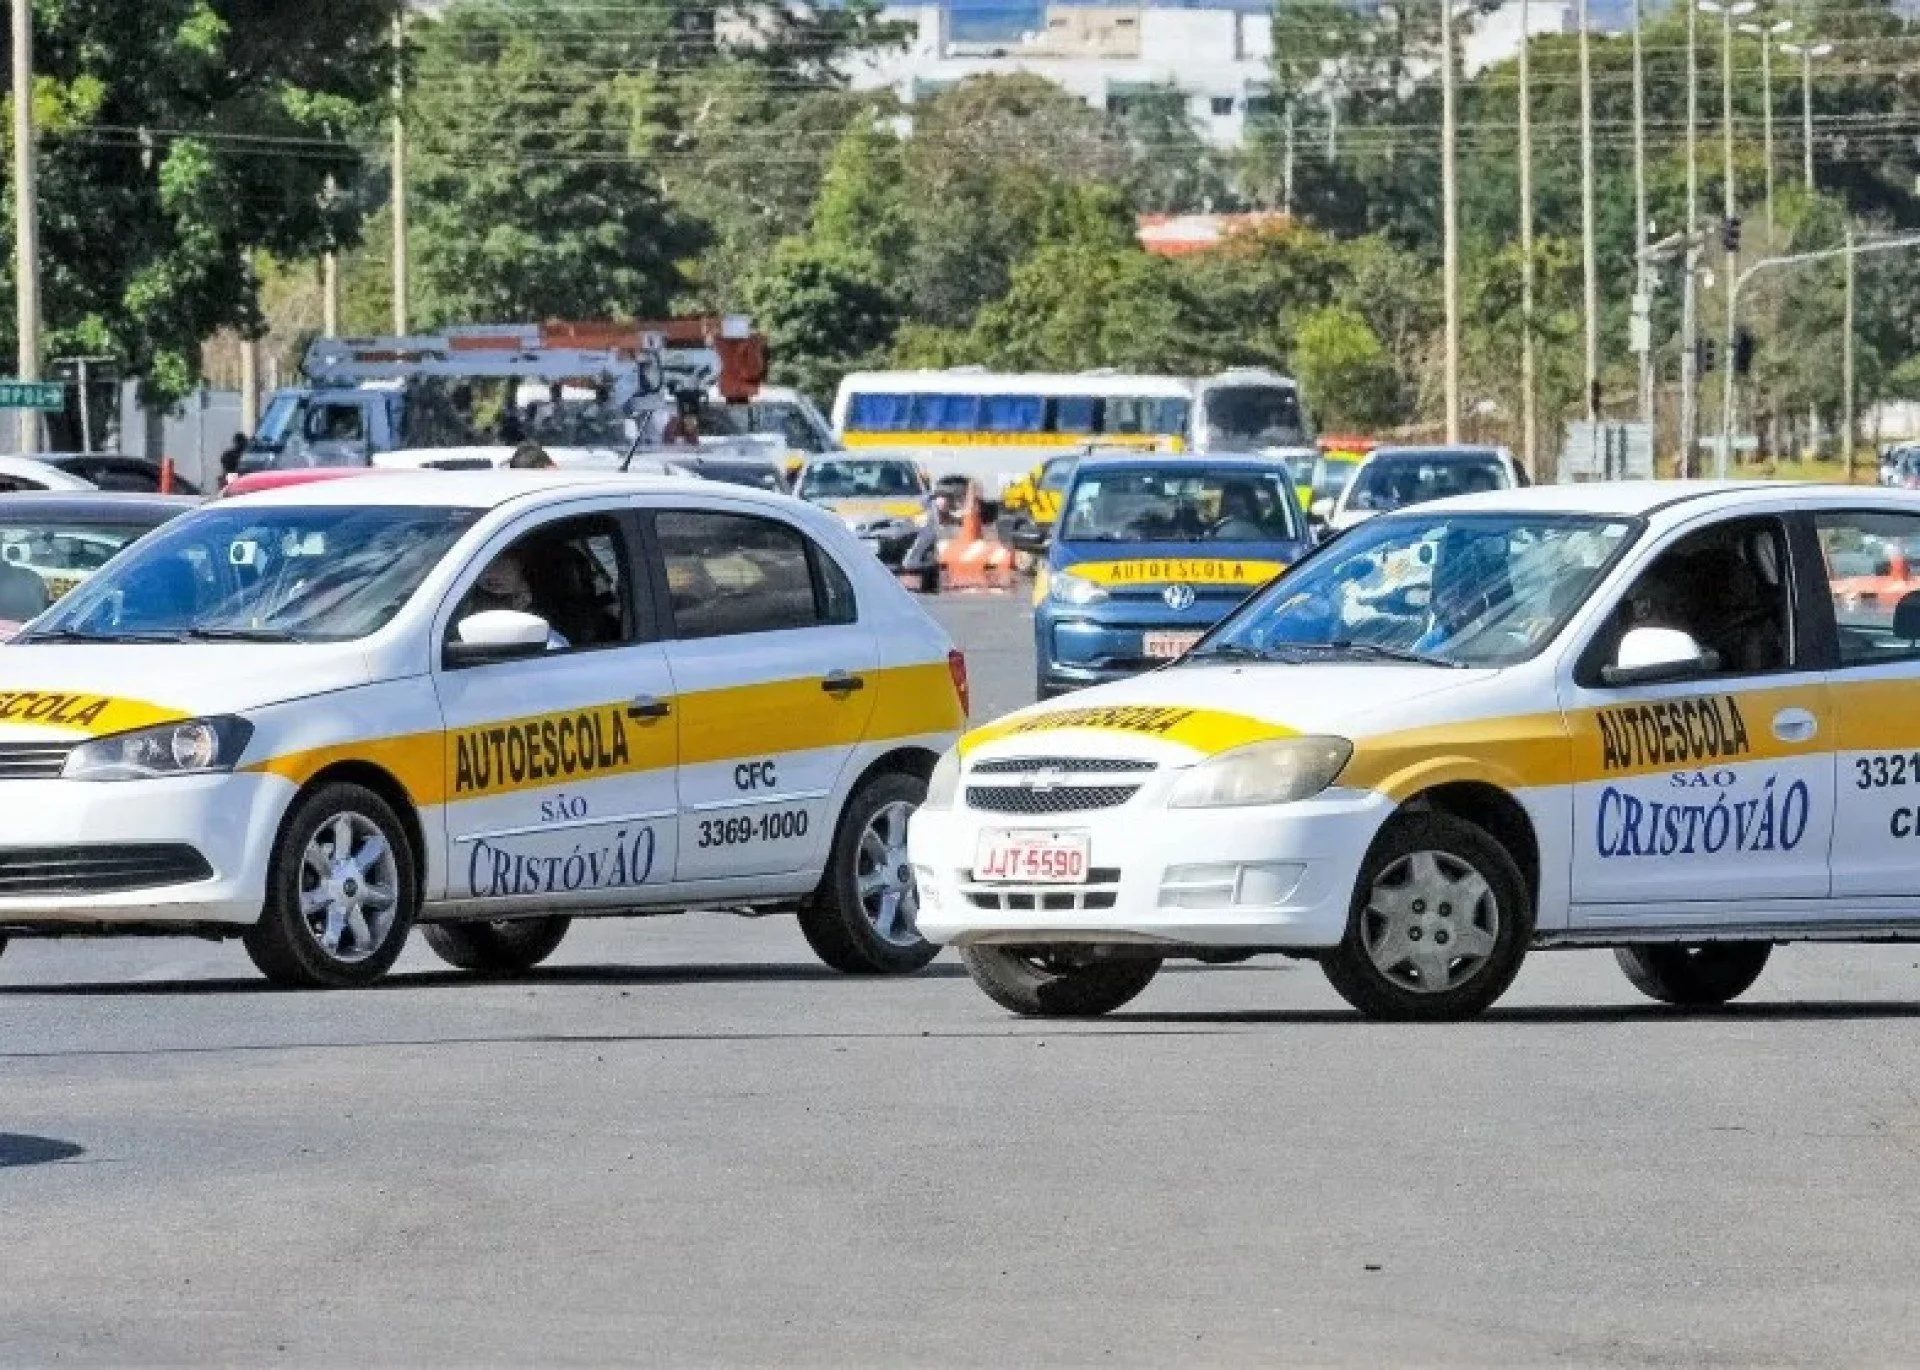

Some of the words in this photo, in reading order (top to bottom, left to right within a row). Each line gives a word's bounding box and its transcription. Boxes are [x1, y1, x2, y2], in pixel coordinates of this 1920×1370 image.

[1111, 560, 1244, 580] AUTOESCOLA
[455, 710, 629, 792] AUTOESCOLA
[1596, 695, 1749, 770] AUTOESCOLA
[734, 760, 777, 790] CFC
[1855, 752, 1920, 790] 3321
[541, 793, 587, 821] SÃO
[1597, 772, 1810, 858] CRISTÓVÃO
[698, 809, 808, 848] 3369-1000
[469, 826, 656, 897] CRISTÓVÃO
